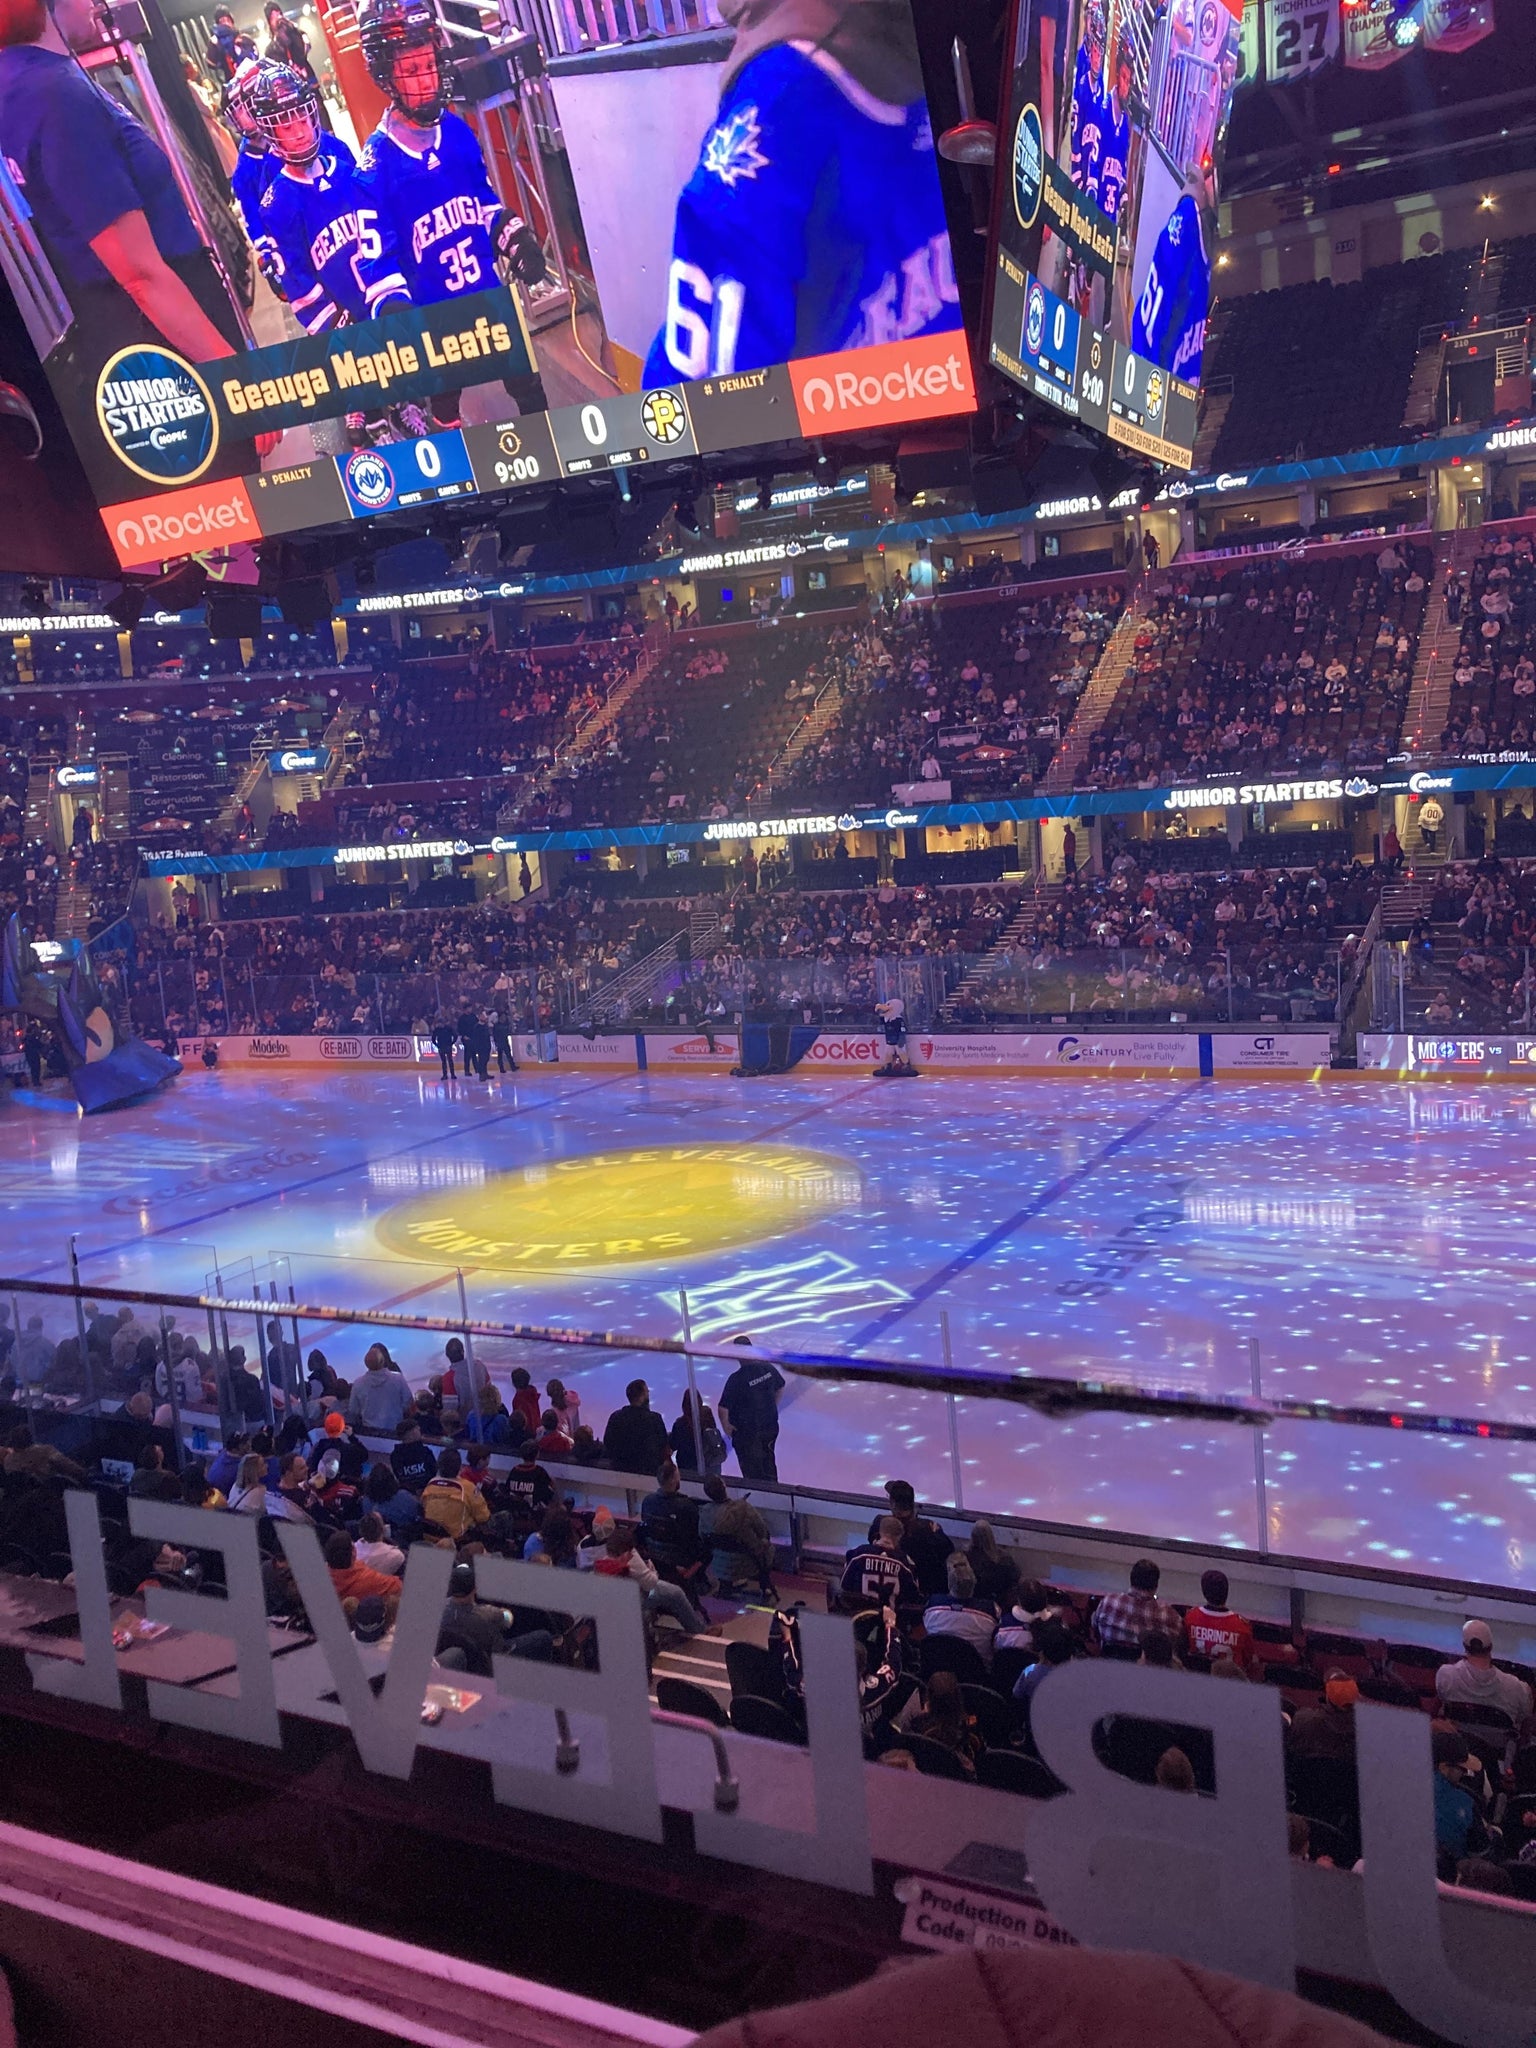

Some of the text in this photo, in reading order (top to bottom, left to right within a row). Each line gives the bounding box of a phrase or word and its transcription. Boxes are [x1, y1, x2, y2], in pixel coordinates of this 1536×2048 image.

[1275, 10, 1329, 69] 27
[1070, 202, 1092, 245] Maple
[1091, 223, 1114, 264] Leafs
[440, 236, 481, 292] 35
[665, 259, 746, 379] 61
[1053, 304, 1065, 351] 0
[222, 316, 512, 415] Geauga Maple Leafs
[1124, 354, 1136, 395] 0
[102, 376, 178, 409] JUNIOR
[719, 374, 765, 393] PENALTY
[834, 353, 965, 410] Rocket
[1081, 369, 1104, 407] 9:00
[105, 394, 206, 437] STARTERS
[580, 404, 607, 445] 0
[651, 398, 676, 437] P
[158, 429, 188, 446] NOPEC
[506, 438, 513, 448] 1
[414, 439, 441, 478] 0
[494, 455, 540, 484] 9:00
[1171, 446, 1180, 461] FOR
[1180, 450, 1190, 466] $40
[272, 466, 312, 485] PENALTY
[770, 486, 818, 504] STARTERS
[1035, 496, 1090, 519] JUNIOR
[141, 495, 250, 544] Rocket
[679, 544, 786, 574] JUNIOR STARTERS
[356, 588, 464, 612] JUNIOR STARTERS
[43, 614, 114, 631] STARTERS
[1164, 778, 1343, 809] JUNIOR STARTERS
[703, 814, 837, 841] JUNIOR STARTERS
[1427, 809, 1439, 819] 00
[333, 841, 454, 863] JUNIOR STARTERS
[251, 1038, 286, 1054] Modelo
[324, 1041, 358, 1055] RE-BATH
[372, 1041, 407, 1055] RE-BATH
[934, 1045, 965, 1053] University
[967, 1044, 997, 1052] Hospitals
[1081, 1048, 1133, 1057] CENTURY
[1133, 1042, 1154, 1051] Bank
[1133, 1052, 1152, 1061] Live
[553, 1148, 836, 1181] CLEVELAND
[406, 1217, 693, 1260] MONSTERS
[403, 1463, 426, 1476] KSK
[865, 1558, 901, 1575] BITTNER
[1190, 1625, 1240, 1646] DEBRINCAT
[920, 1887, 1027, 1934] Production
